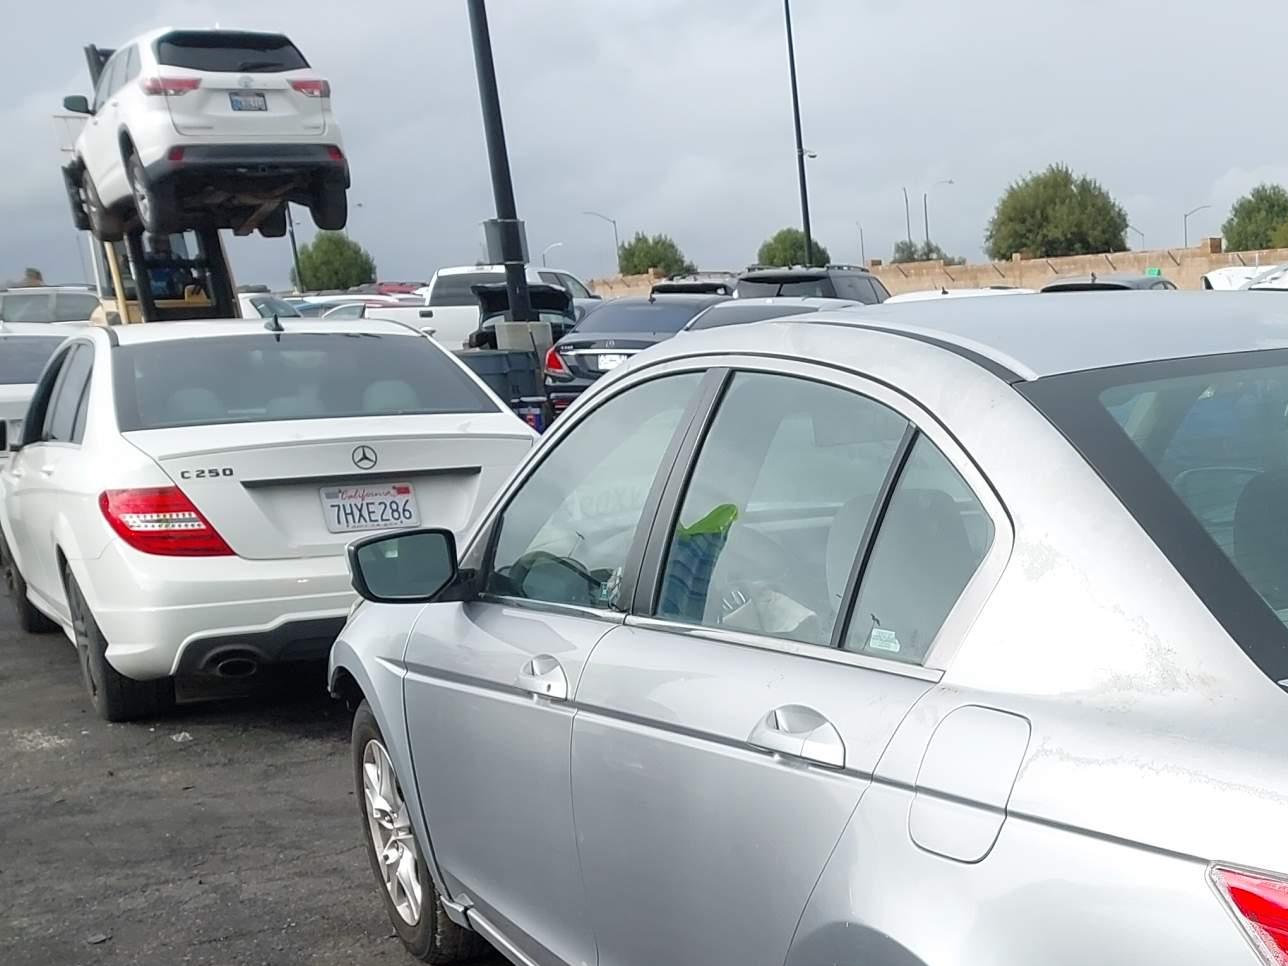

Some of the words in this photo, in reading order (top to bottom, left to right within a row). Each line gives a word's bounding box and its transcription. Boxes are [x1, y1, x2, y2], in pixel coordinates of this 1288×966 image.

[180, 470, 191, 480] C
[195, 467, 234, 478] 250
[340, 487, 398, 501] California
[330, 499, 412, 525] 7HXE286
